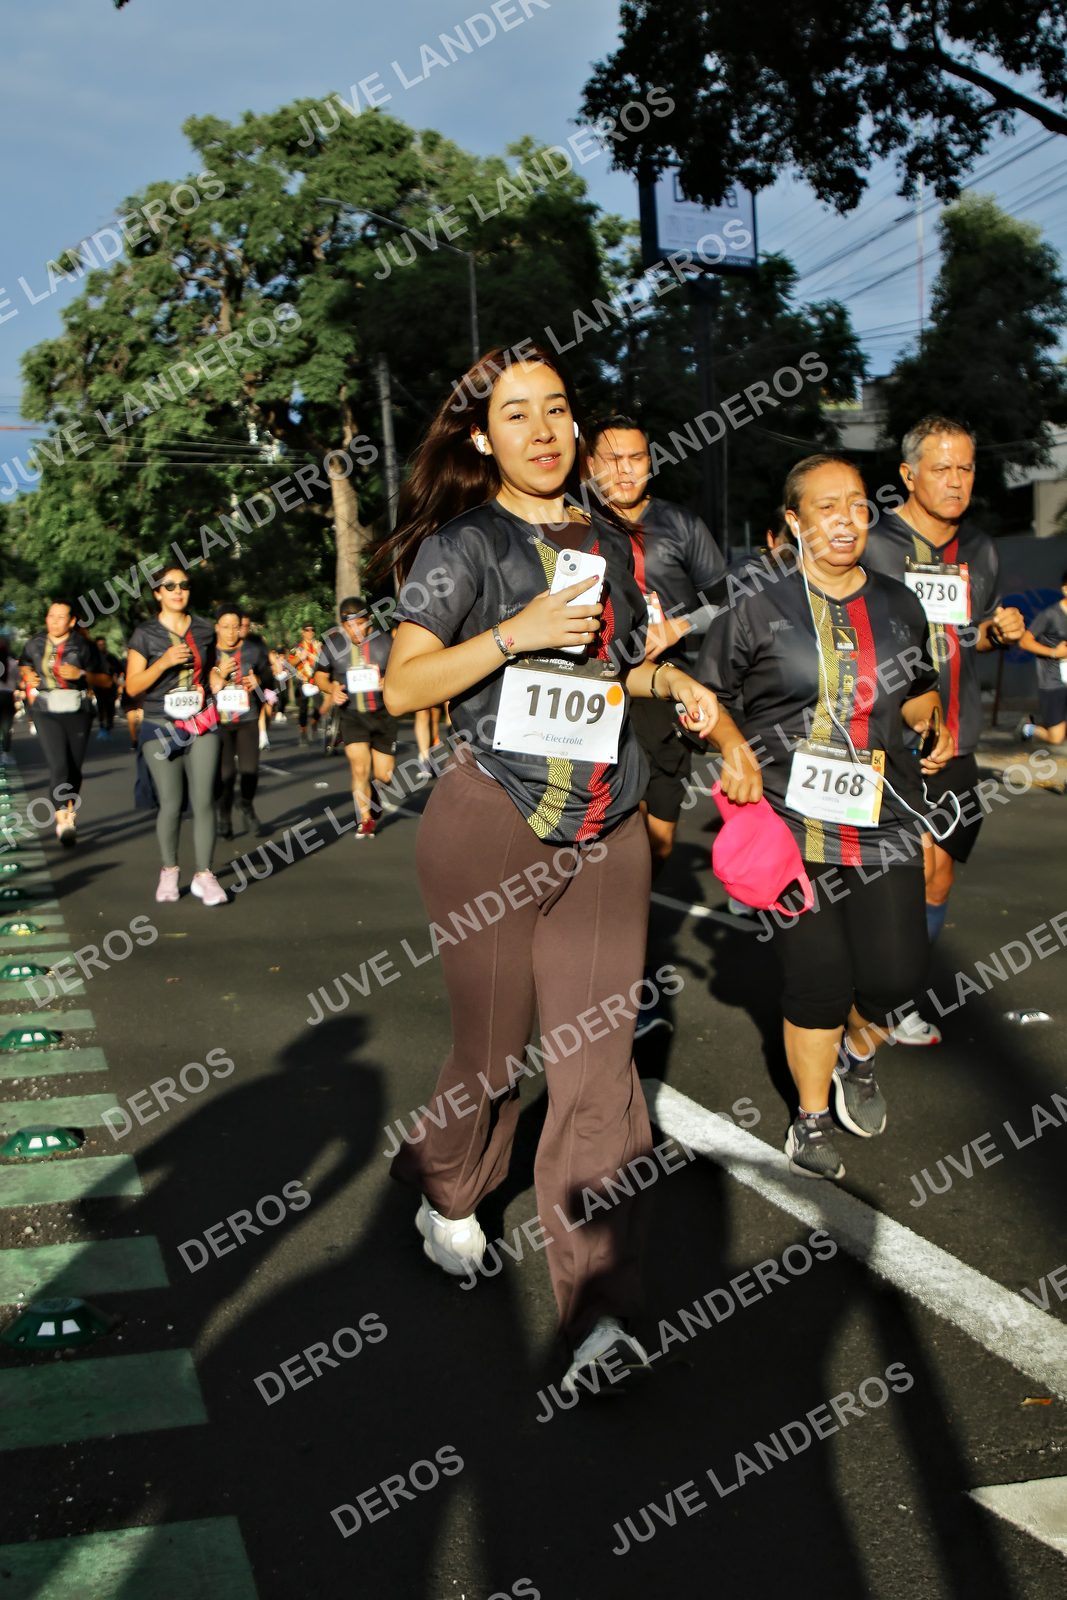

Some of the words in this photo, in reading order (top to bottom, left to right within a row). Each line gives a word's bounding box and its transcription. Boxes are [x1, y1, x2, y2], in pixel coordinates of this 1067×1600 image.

[914, 581, 958, 602] 8730
[526, 683, 606, 725] 1109
[544, 733, 584, 747] Electrolit
[801, 764, 866, 797] 2168
